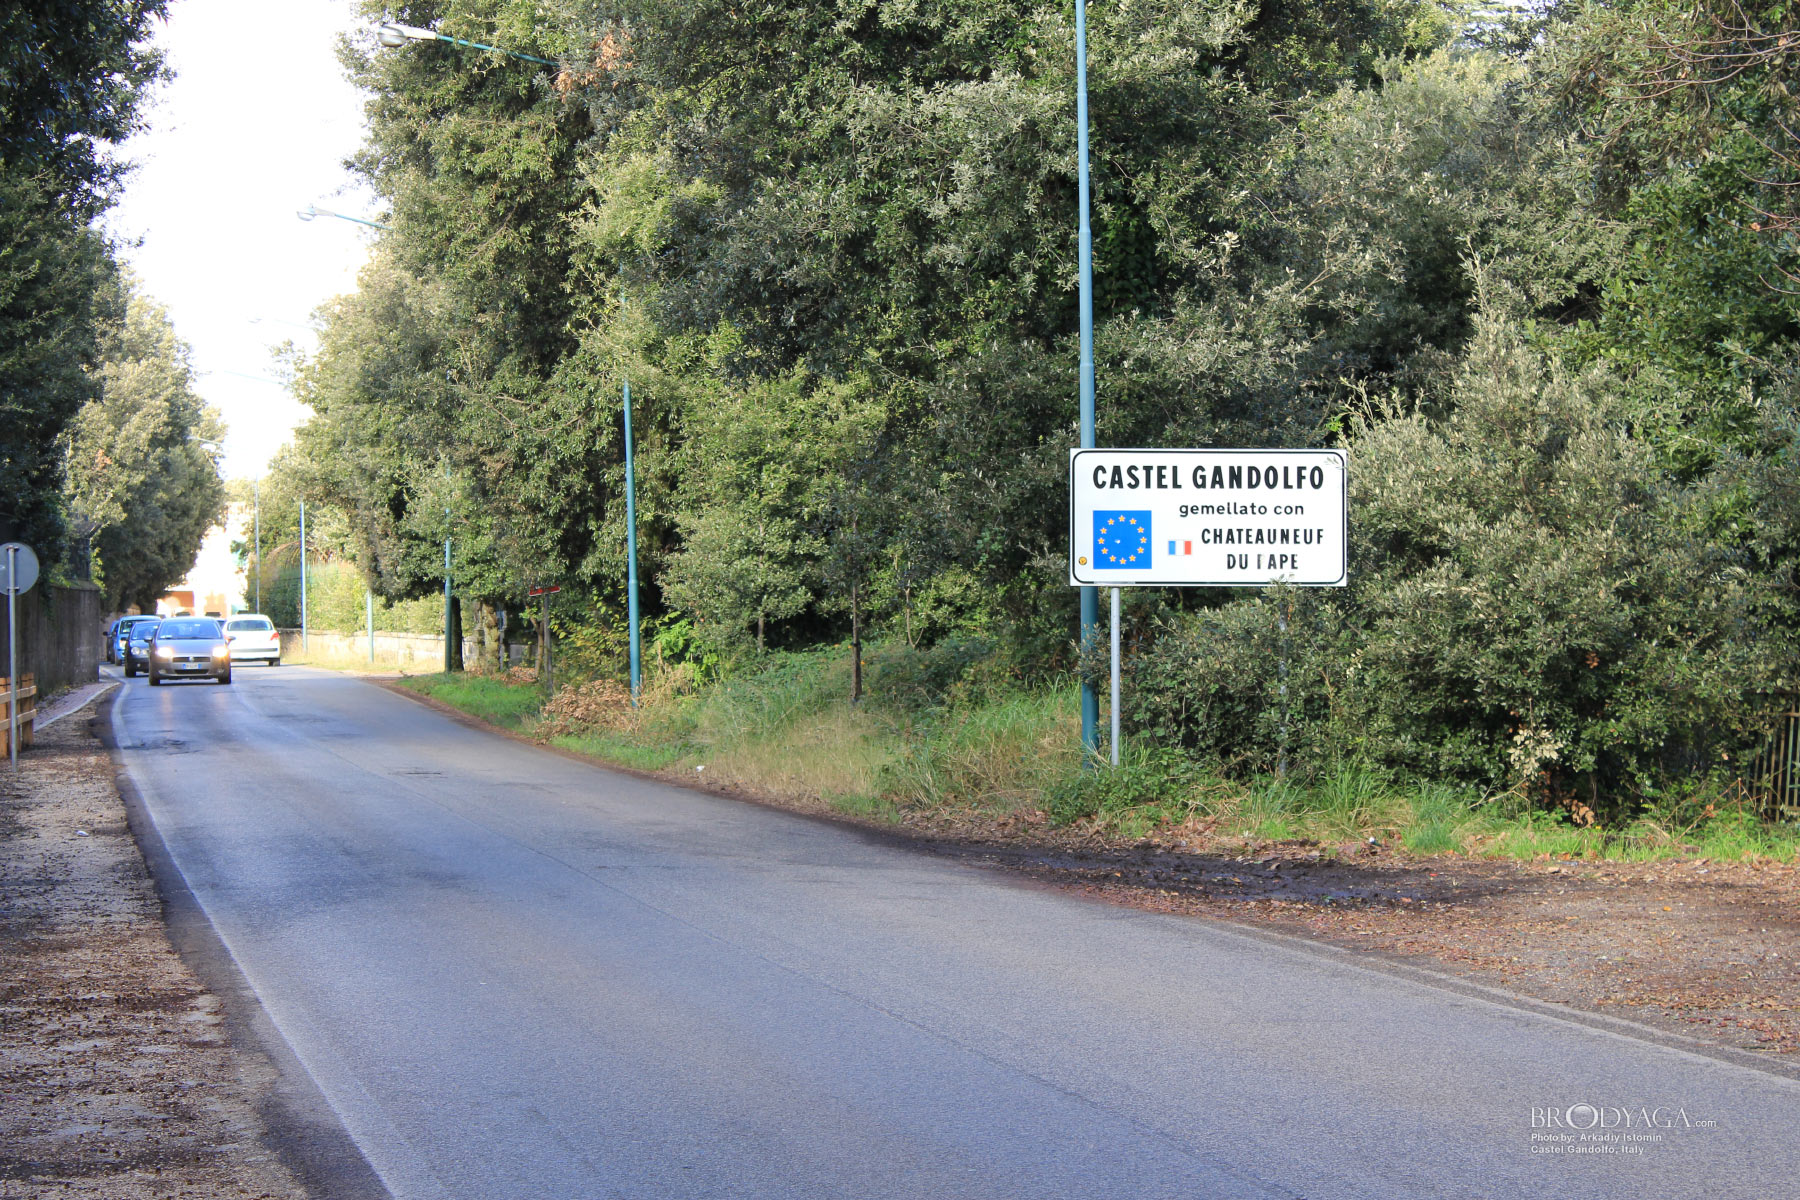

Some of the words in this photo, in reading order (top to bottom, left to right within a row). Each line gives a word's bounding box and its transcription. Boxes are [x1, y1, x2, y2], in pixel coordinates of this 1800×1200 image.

[1093, 465, 1182, 489] CASTEL
[1192, 465, 1324, 489] GANDOLFO
[1179, 502, 1267, 517] gemellato
[1274, 505, 1304, 515] con
[1201, 529, 1324, 544] CHATEAUNEUF
[1227, 554, 1248, 569] DU
